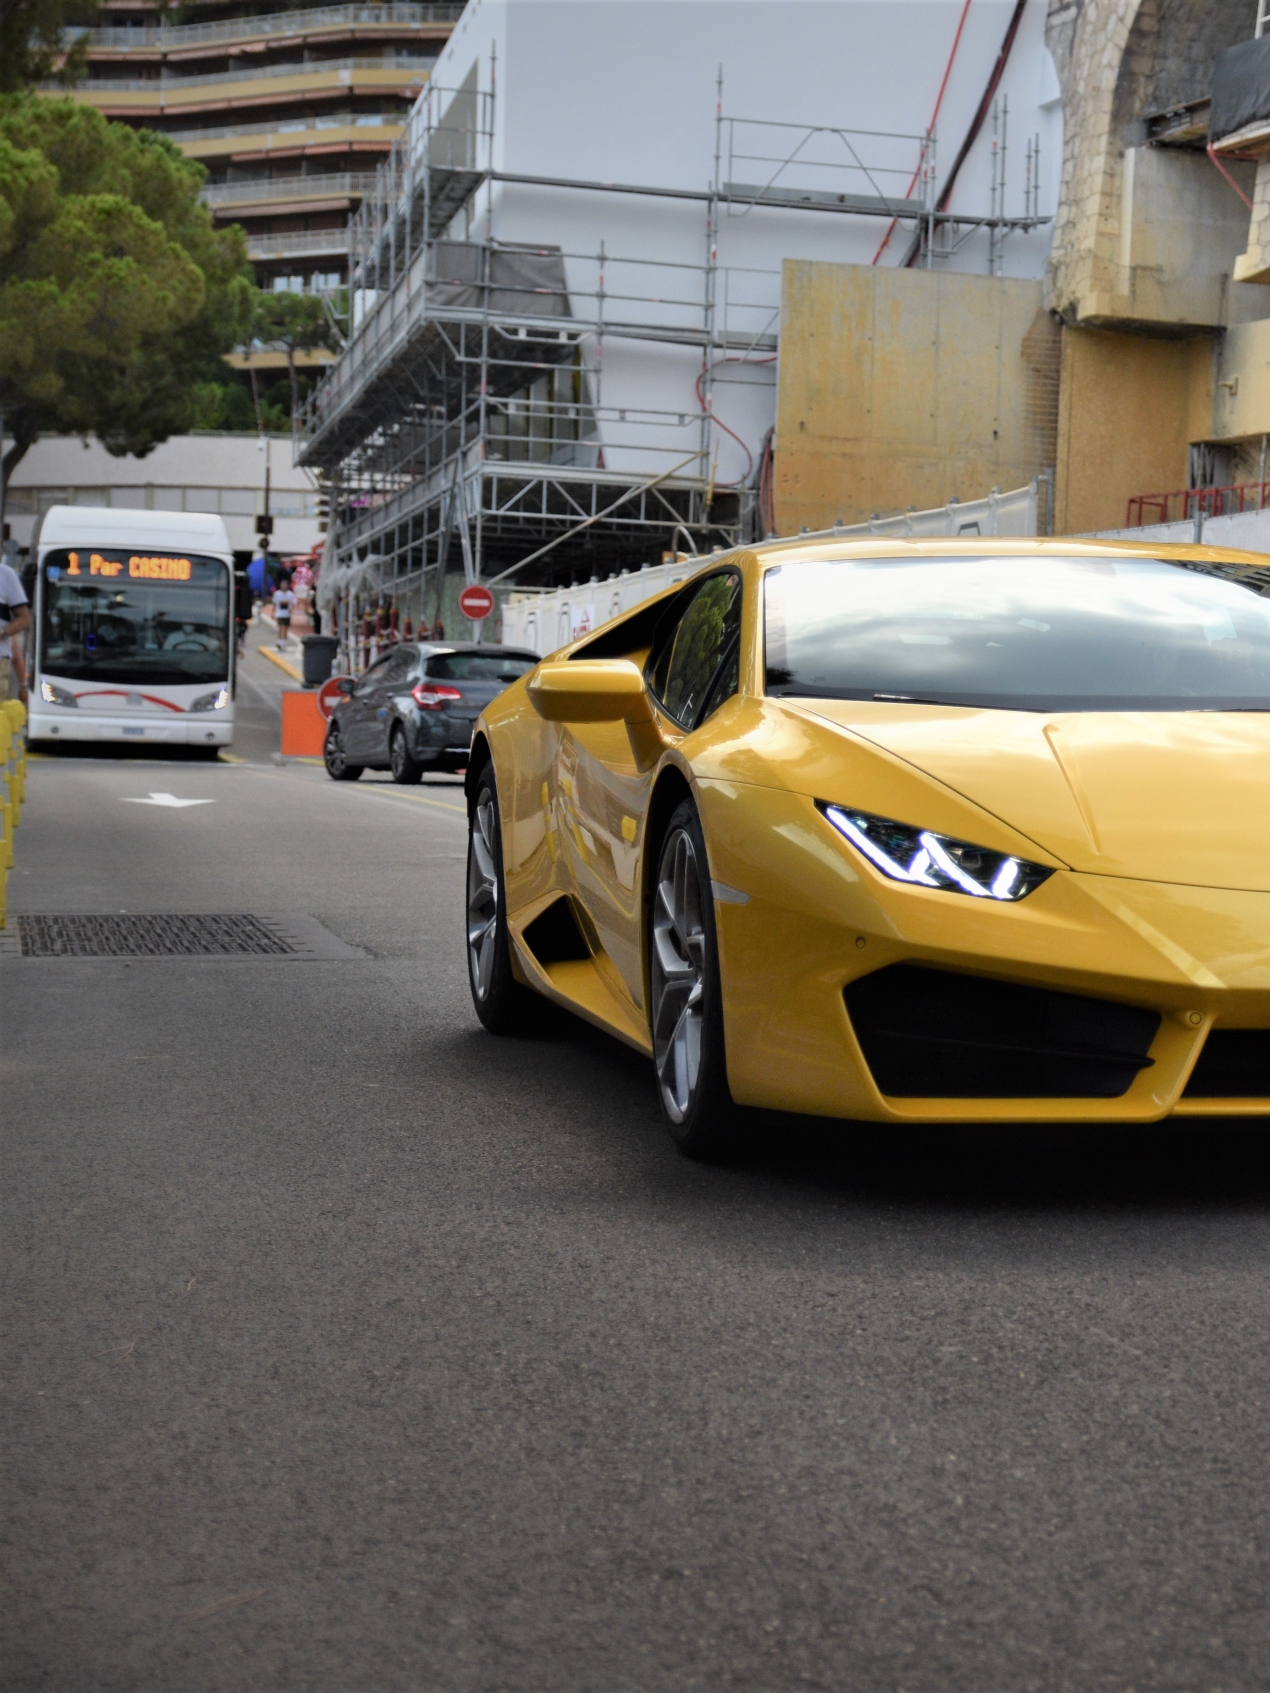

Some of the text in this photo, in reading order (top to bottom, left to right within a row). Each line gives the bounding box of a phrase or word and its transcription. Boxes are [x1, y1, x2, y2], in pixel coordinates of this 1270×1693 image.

[67, 552, 191, 580] 1 Par CASINO
